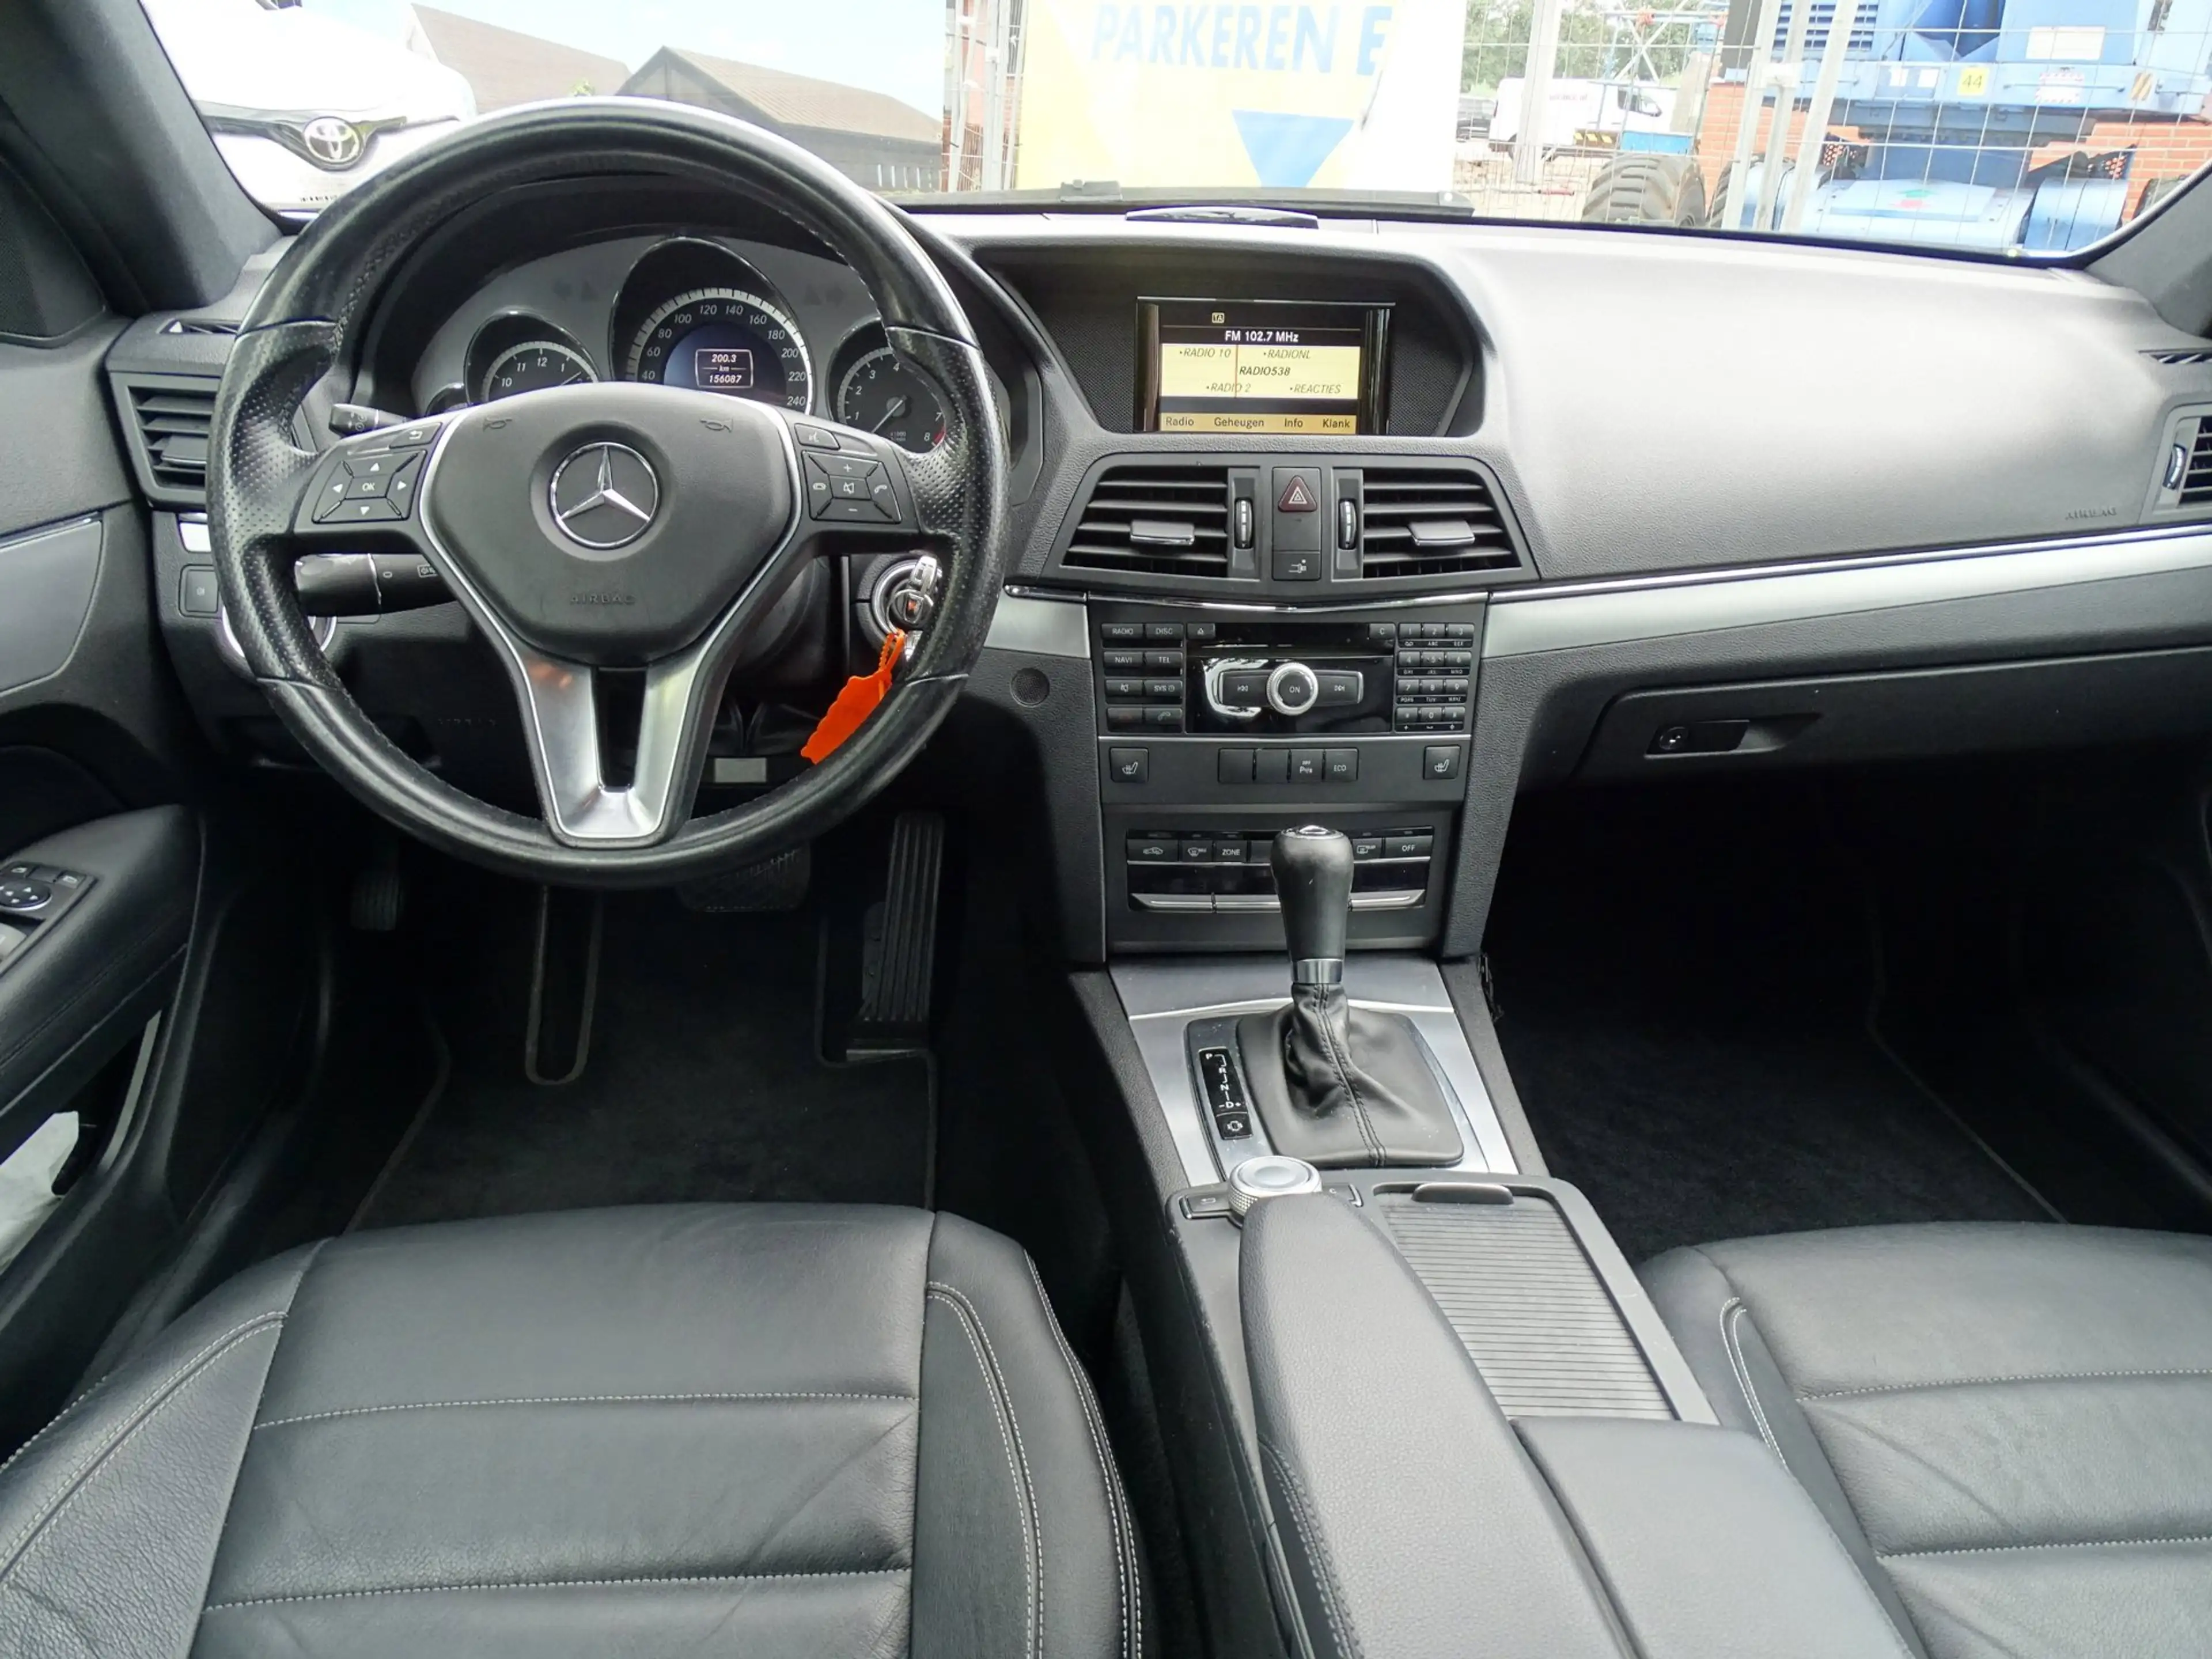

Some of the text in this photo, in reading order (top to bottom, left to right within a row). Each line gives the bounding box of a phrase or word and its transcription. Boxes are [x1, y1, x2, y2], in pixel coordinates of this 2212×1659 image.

[1091, 5, 1339, 74] PARKEREN
[1963, 74, 1983, 88] 44
[700, 304, 717, 315] 120
[725, 305, 744, 315] 140
[674, 314, 691, 324] 100
[749, 315, 767, 324] 160
[658, 328, 672, 338] 80
[767, 329, 785, 340] 180
[1225, 331, 1299, 343] FM 102.7 MHz
[647, 347, 661, 357] 60
[781, 348, 799, 358] 200
[1183, 349, 1231, 358] RADIO 10
[1267, 350, 1311, 359] RADIONL
[537, 358, 547, 367] 12
[711, 354, 737, 363] 200.3
[517, 363, 526, 372] 11
[561, 363, 565, 372] 1
[893, 362, 900, 372] 4
[1239, 366, 1291, 376] RADIO538
[642, 370, 656, 380] 40
[709, 374, 742, 384] 156087
[789, 372, 806, 381] 220
[869, 370, 876, 379] 3
[501, 377, 512, 388] 10
[855, 386, 862, 395] 2
[1210, 383, 1251, 393] RADIO 2
[1294, 384, 1342, 394] REACTIES
[787, 396, 806, 406] 240
[854, 411, 859, 421] 1
[935, 412, 942, 421] 7
[1166, 416, 1350, 430] Radio Geheugen Info Klank
[923, 432, 930, 441] 8
[362, 482, 375, 491] OK
[1220, 1084, 1229, 1092] N
[1225, 1101, 1234, 1109] D
